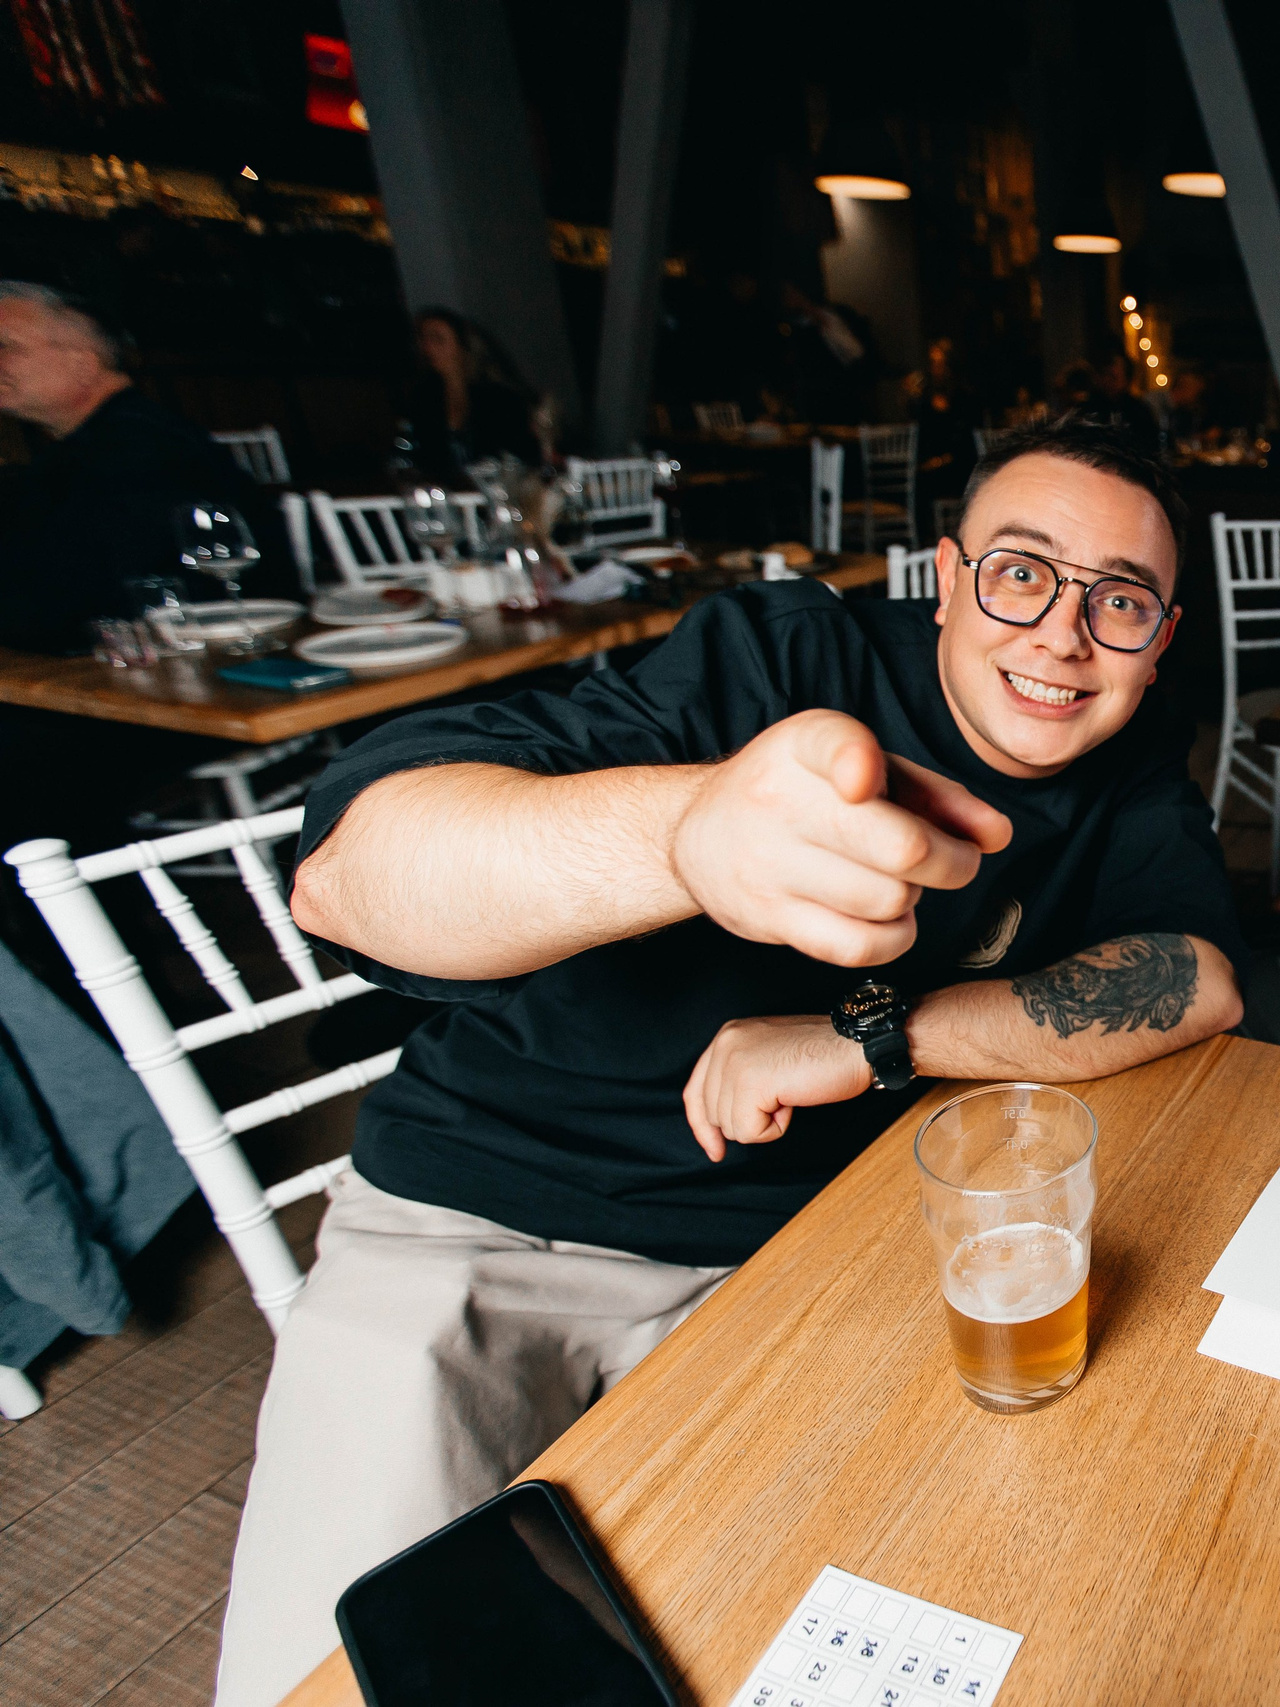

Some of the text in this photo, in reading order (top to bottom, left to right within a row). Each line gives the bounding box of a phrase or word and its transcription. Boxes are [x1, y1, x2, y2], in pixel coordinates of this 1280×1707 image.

[802, 1618, 818, 1635] 17
[860, 1639, 878, 1657] 18
[808, 1662, 827, 1681] 23
[901, 1656, 919, 1673] 13
[933, 1667, 949, 1685] 10
[753, 1687, 773, 1706] 39
[790, 1699, 804, 1707] 3
[880, 1689, 899, 1707] 21
